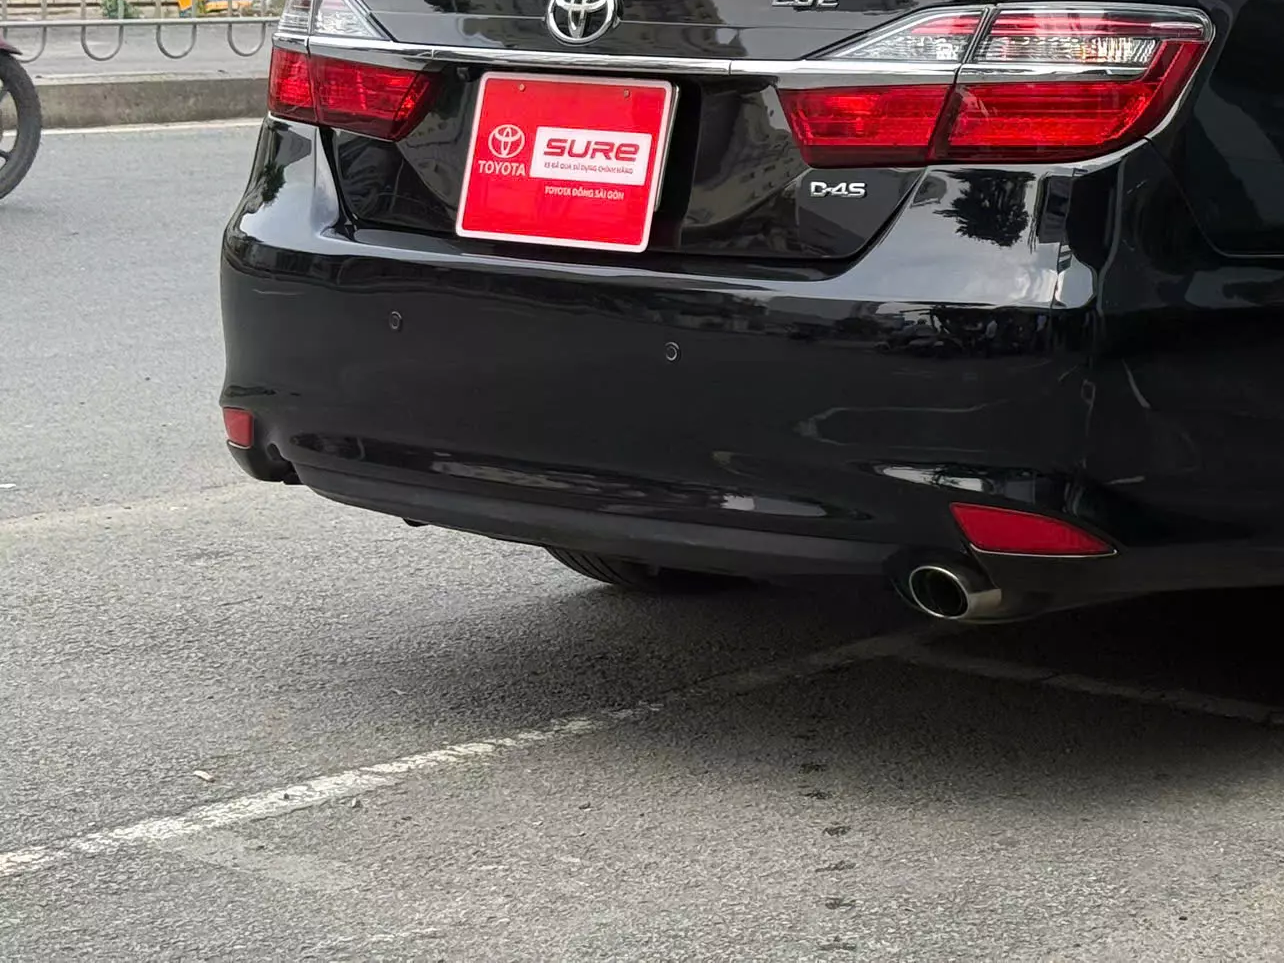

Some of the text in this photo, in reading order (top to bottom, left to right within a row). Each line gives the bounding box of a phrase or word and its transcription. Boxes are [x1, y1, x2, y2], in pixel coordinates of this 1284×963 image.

[478, 160, 526, 177] TOYOTA
[544, 185, 571, 196] TOYOTA
[810, 181, 867, 197] D-4S
